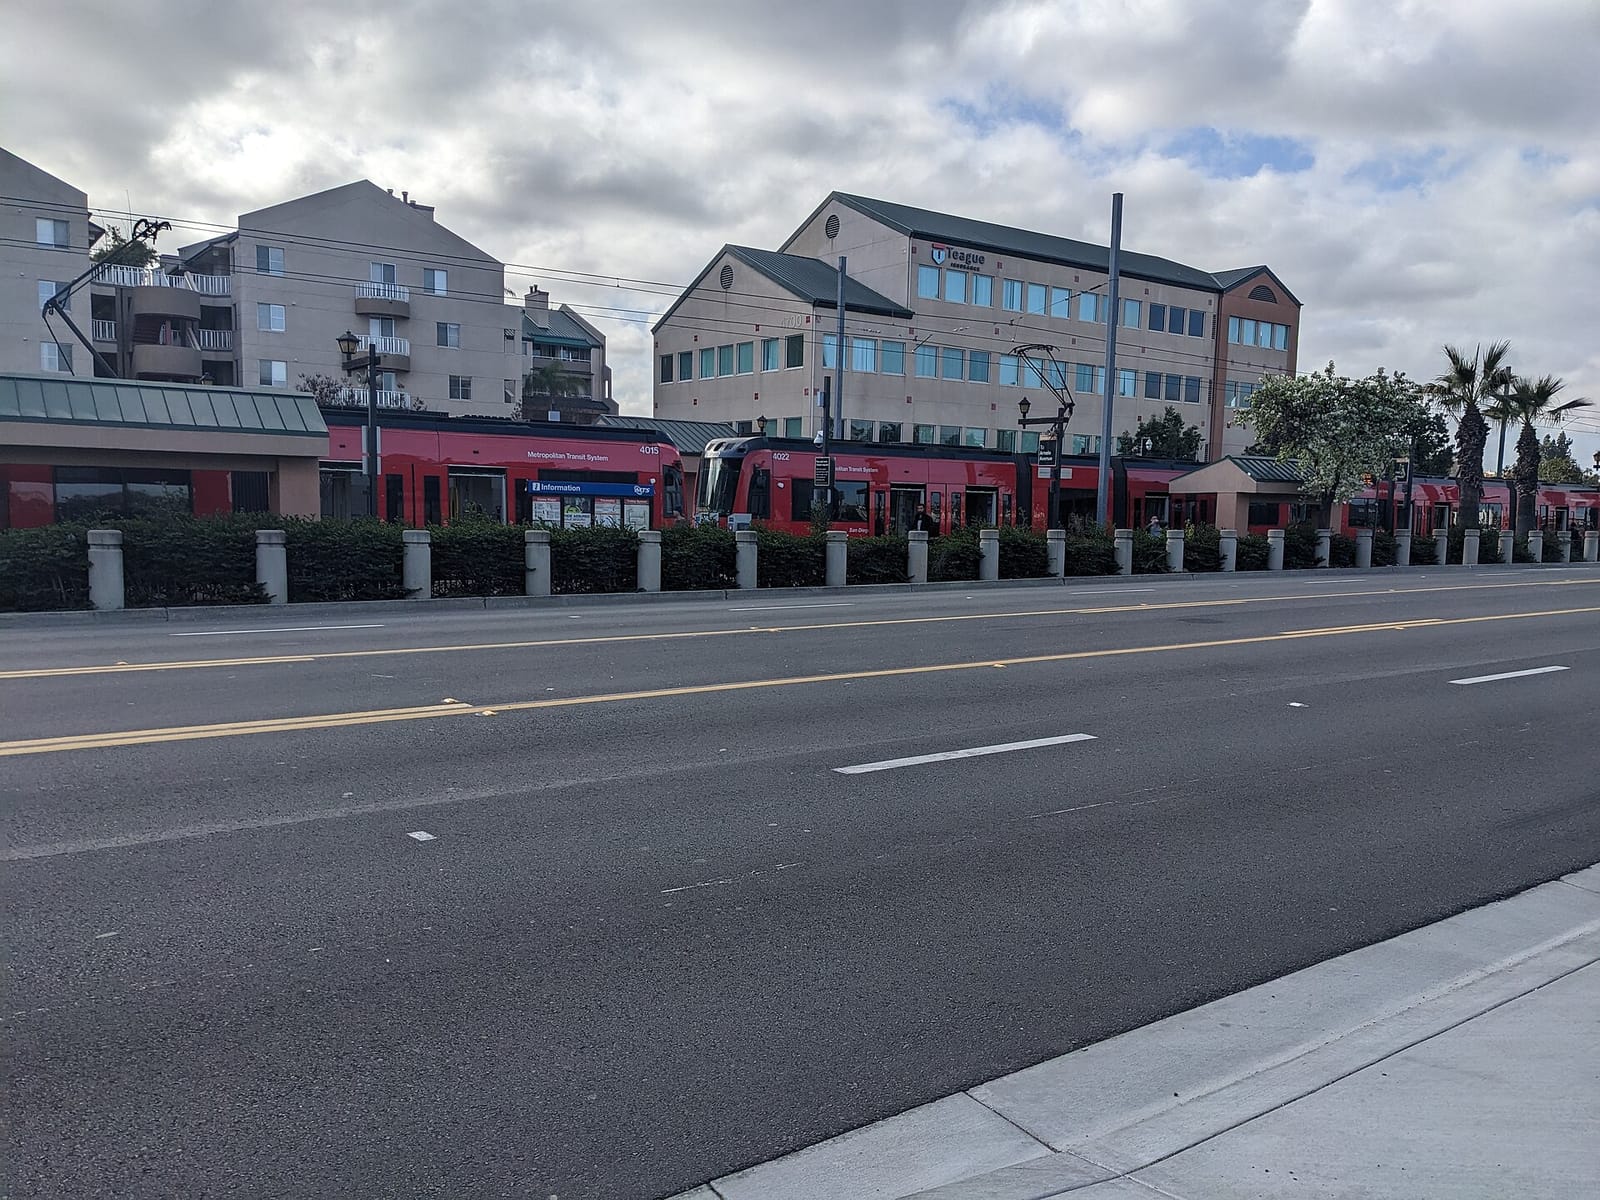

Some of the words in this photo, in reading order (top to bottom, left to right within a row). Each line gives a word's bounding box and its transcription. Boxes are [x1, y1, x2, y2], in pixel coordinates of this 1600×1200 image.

[946, 247, 985, 265] Teague
[639, 445, 659, 455] 4015
[527, 451, 565, 460] Metropolitan
[567, 453, 586, 461] Transit
[587, 454, 609, 462] System
[772, 452, 790, 461] 4022
[541, 483, 581, 492] Information
